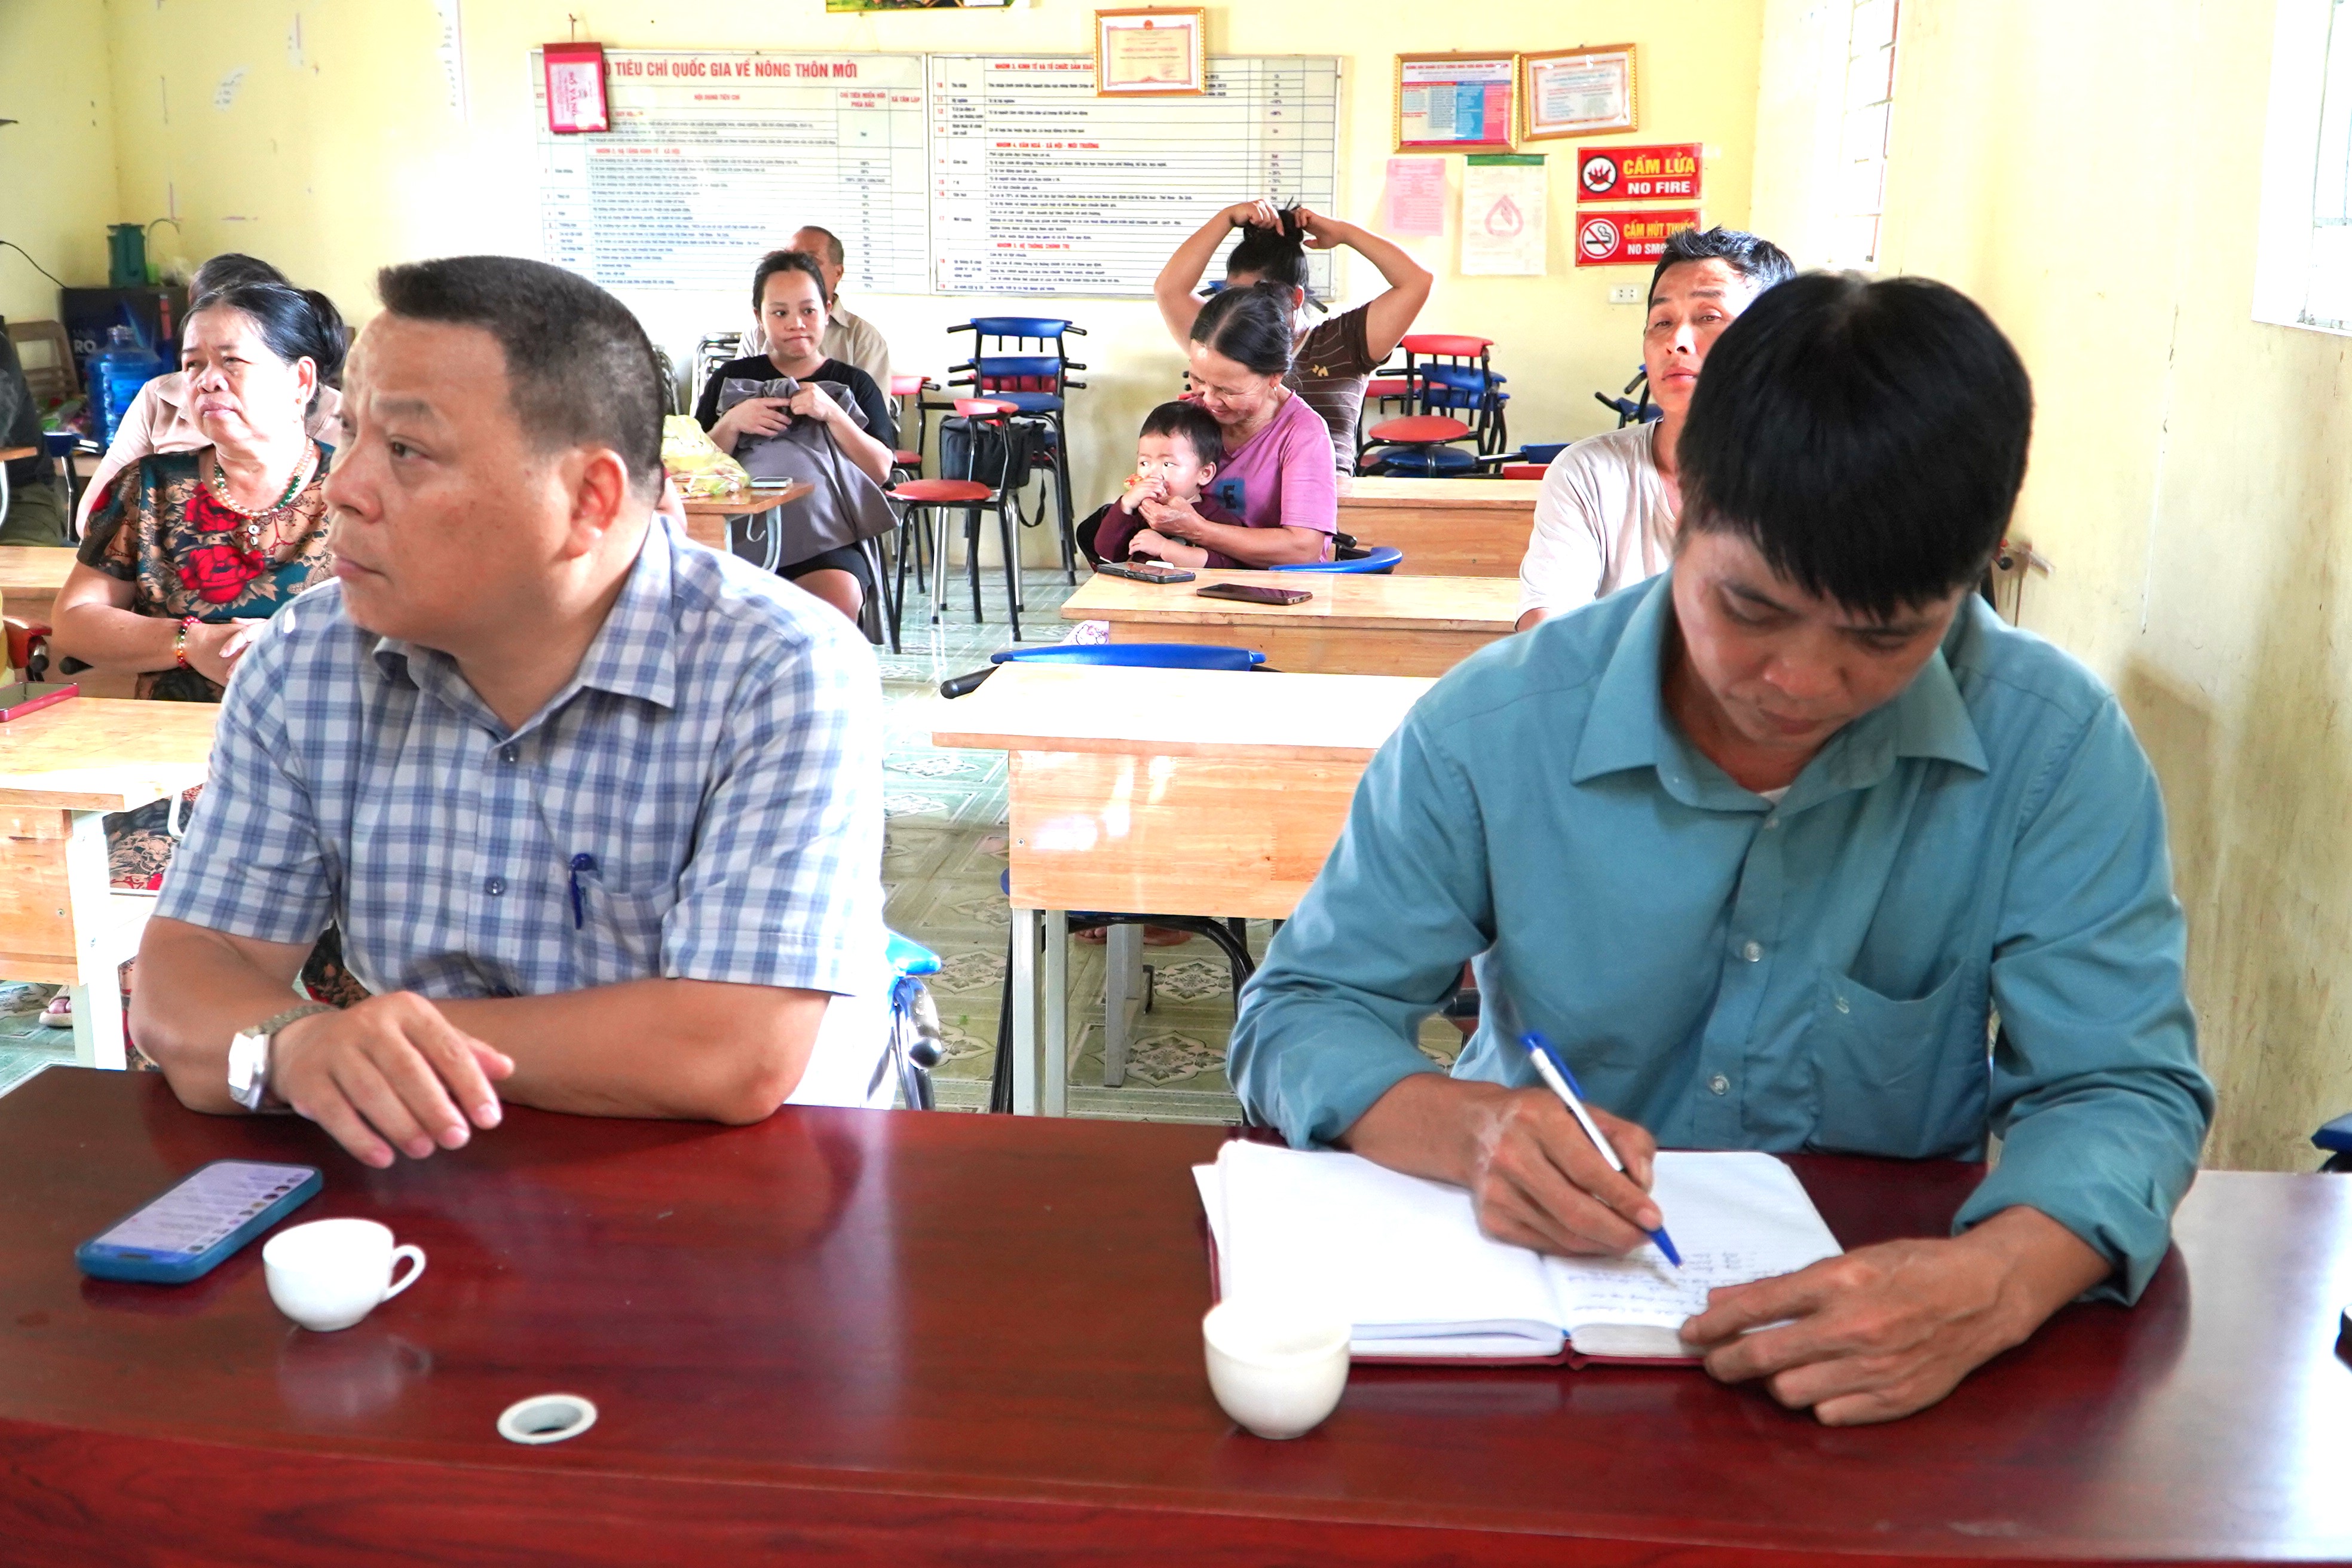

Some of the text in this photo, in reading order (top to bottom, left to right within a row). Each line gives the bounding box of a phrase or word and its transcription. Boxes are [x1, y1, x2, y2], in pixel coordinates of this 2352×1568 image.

[615, 59, 642, 76] TIÊU
[647, 59, 667, 76] CHÍ
[672, 57, 706, 78] QUỐC
[710, 62, 731, 76] GIA
[735, 58, 751, 76] VỀ
[755, 60, 791, 77] NÔNG
[795, 60, 828, 78] THÔN
[832, 59, 857, 78] MỚI
[1623, 152, 1696, 175] CẤM LỬA
[1628, 180, 1690, 195] NO FIRE
[1624, 219, 1645, 238] CẤM
[1647, 220, 1665, 237] HÚT
[1628, 242, 1668, 255] NO SMO
